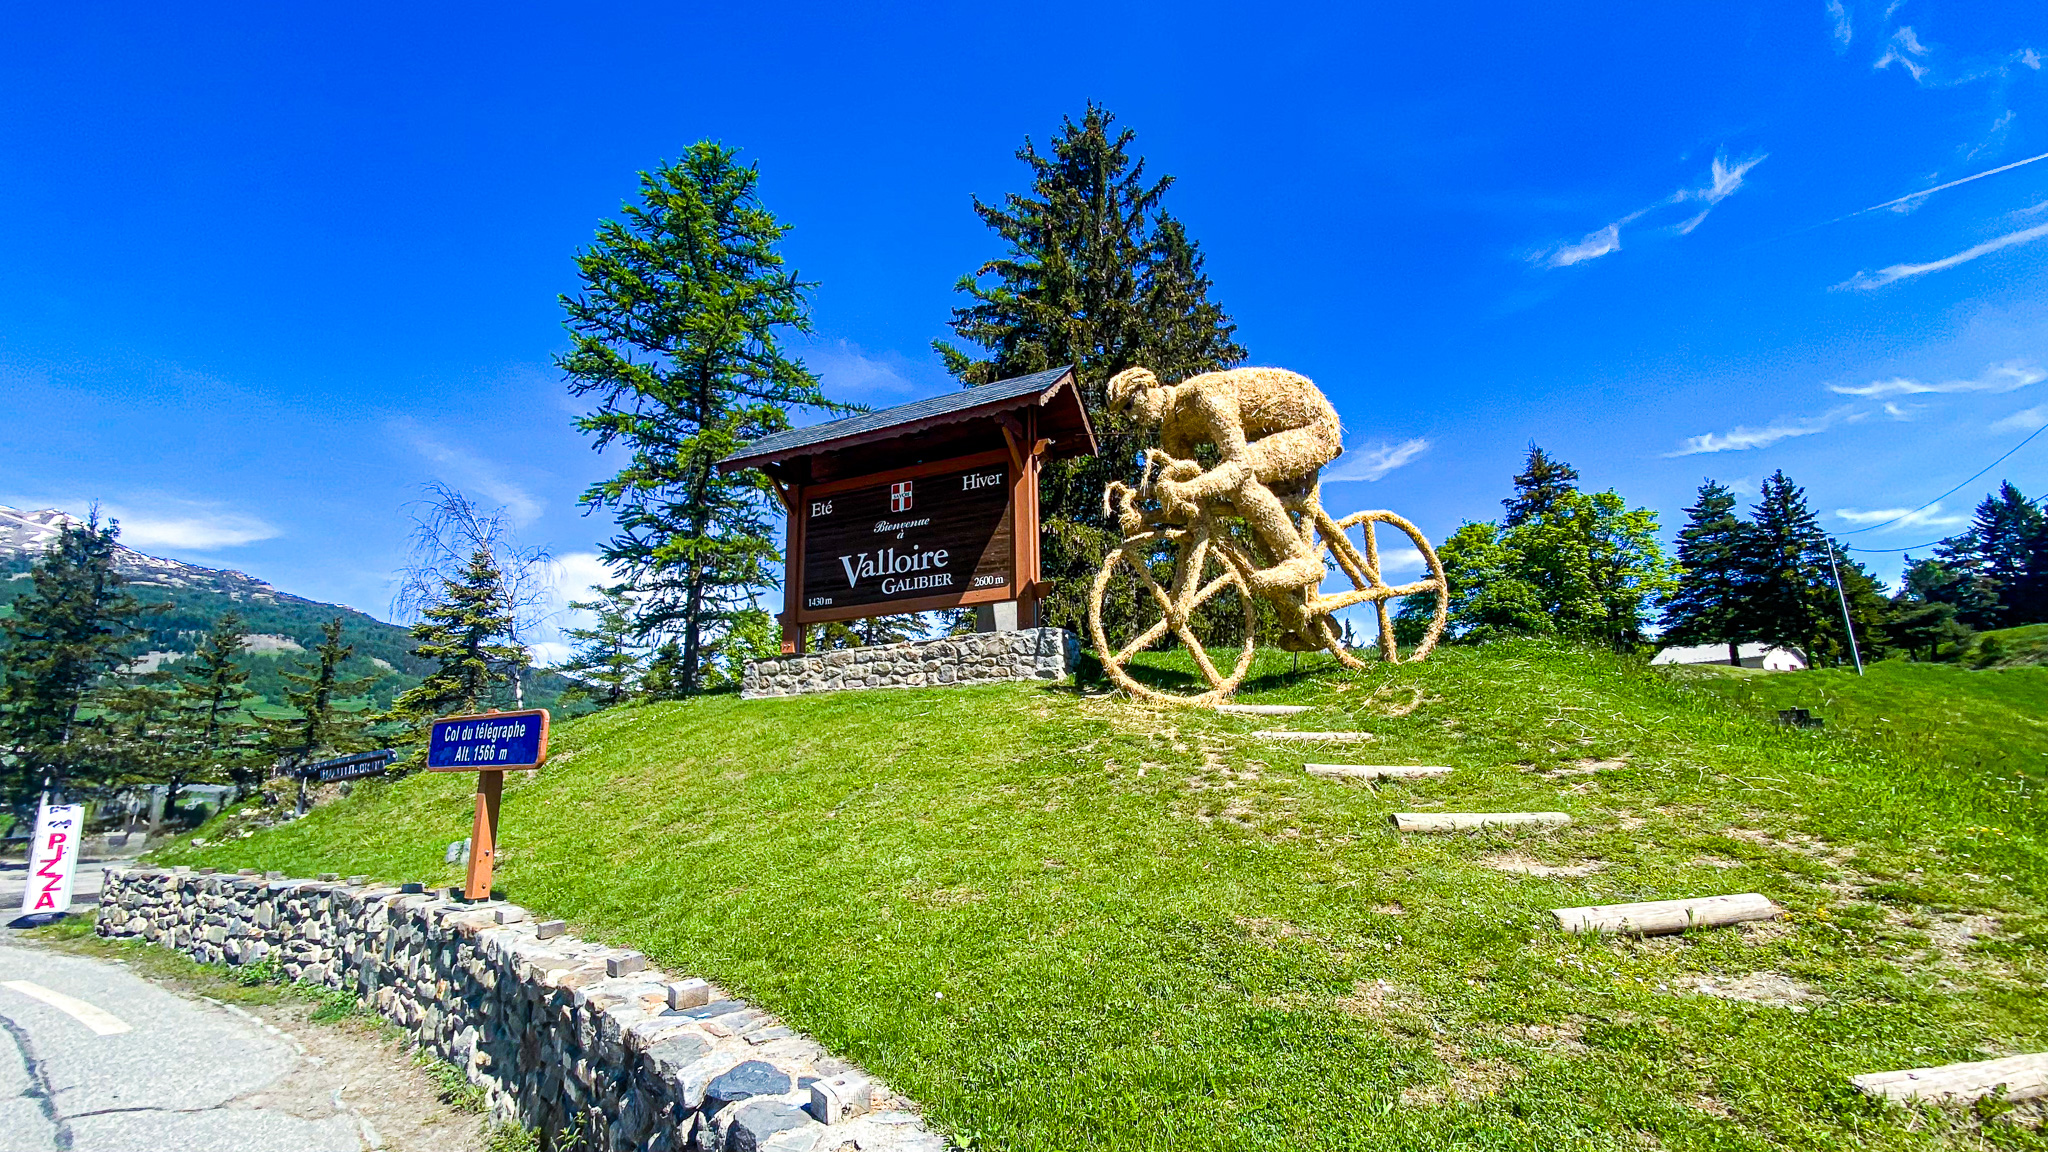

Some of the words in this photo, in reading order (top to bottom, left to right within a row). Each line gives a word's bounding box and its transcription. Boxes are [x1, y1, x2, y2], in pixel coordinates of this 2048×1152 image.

[962, 472, 1003, 491] Hiver
[811, 500, 833, 517] Eté
[873, 517, 930, 533] Bienvenue
[896, 529, 905, 540] à
[838, 544, 949, 589] Valloire
[881, 573, 953, 595] GALIBIER
[974, 576, 994, 587] 2600
[808, 597, 825, 607] 1430
[825, 598, 833, 606] m
[444, 725, 461, 742] Col
[461, 725, 473, 740] du
[474, 720, 526, 743] télégraphe
[454, 746, 470, 762] Alt.
[473, 744, 496, 761] 1566
[498, 748, 508, 760] m
[33, 833, 67, 910] PIZZA
